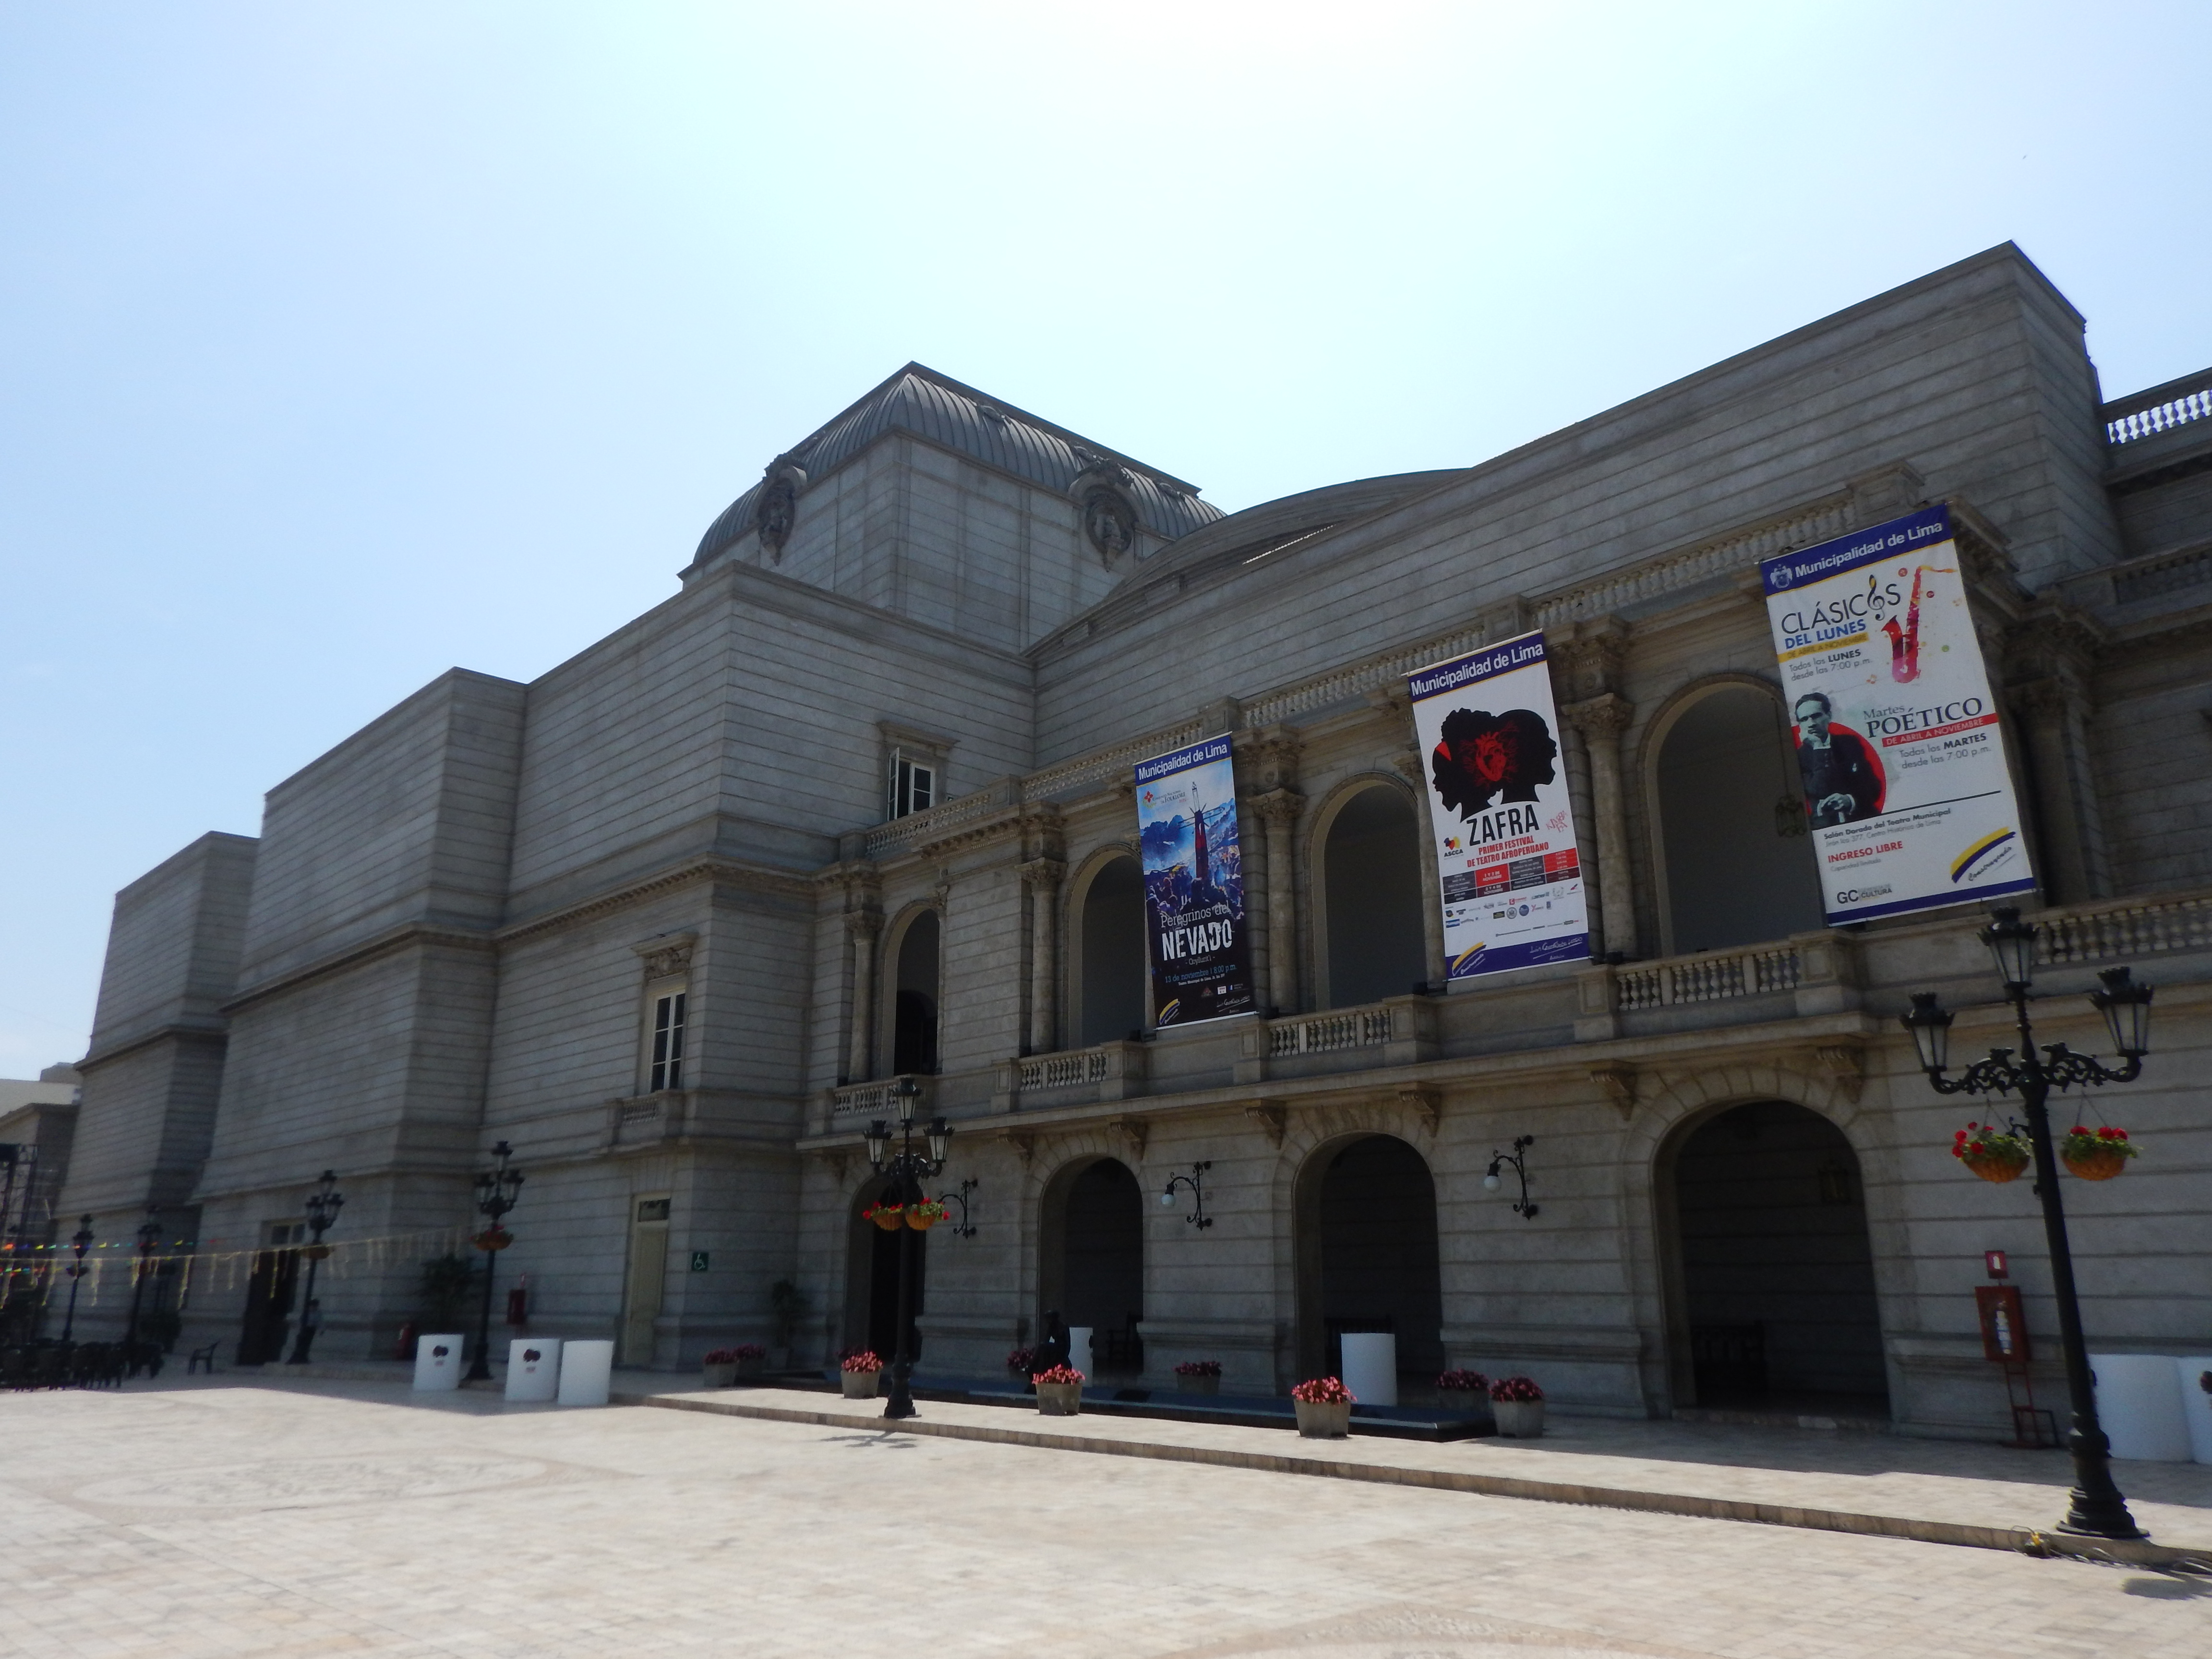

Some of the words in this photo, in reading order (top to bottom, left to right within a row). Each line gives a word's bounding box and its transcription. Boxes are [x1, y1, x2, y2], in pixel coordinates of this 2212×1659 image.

[1795, 539, 1884, 577] Municipalidad
[1887, 533, 1905, 547] de
[1908, 521, 1943, 541] Lima
[1785, 633, 1812, 649] DEL
[1816, 619, 1866, 642] LUNES
[1799, 646, 1815, 656] ABRIL
[1827, 635, 1867, 649] NOVIEMBRE
[1411, 657, 1491, 696] Municipalidad
[1493, 653, 1509, 670] de
[1511, 644, 1544, 663] Lima
[1789, 659, 1811, 672] Todos
[1828, 649, 1861, 662] LUNES
[1791, 669, 1814, 681] desde
[1831, 661, 1851, 671] 7:00
[1863, 705, 1905, 720] Martes
[1866, 697, 1982, 738] POÉTICO
[1900, 733, 1923, 743] ABRIL
[1935, 718, 1984, 735] NOVIEMBRE
[1899, 747, 1925, 757] Todos
[1944, 733, 1986, 749] MARTES
[1139, 752, 1191, 780] Municipalidad
[1193, 750, 1204, 762] de
[1205, 744, 1227, 758] Lima
[1902, 758, 1928, 769] desde
[1947, 749, 1968, 760] 7:00
[1971, 746, 1992, 757] p.m.
[1467, 804, 1539, 846] ZAFRA
[1824, 831, 1843, 840] Salón
[1846, 825, 1872, 835] Dorado
[1874, 821, 1885, 829] del
[1887, 817, 1911, 826] Teatro
[1913, 808, 1951, 821] Municipal
[1444, 849, 1463, 857] ASCCA
[1467, 859, 1475, 867] DE
[1476, 853, 1500, 865] TEATRO
[1502, 842, 1549, 860] AFROPERUANO
[1479, 842, 1503, 855] PRIMER
[1505, 835, 1534, 849] FESTIVAL
[1828, 847, 1873, 863] INGRESO
[1876, 841, 1903, 854] LIBRE
[1837, 890, 1859, 904] GC
[1861, 888, 1892, 898] CULTURA
[1161, 908, 1211, 928] Peregrinos
[1214, 900, 1230, 915] del
[1162, 919, 1232, 961] NEVADO
[1181, 970, 1209, 980] noviembre
